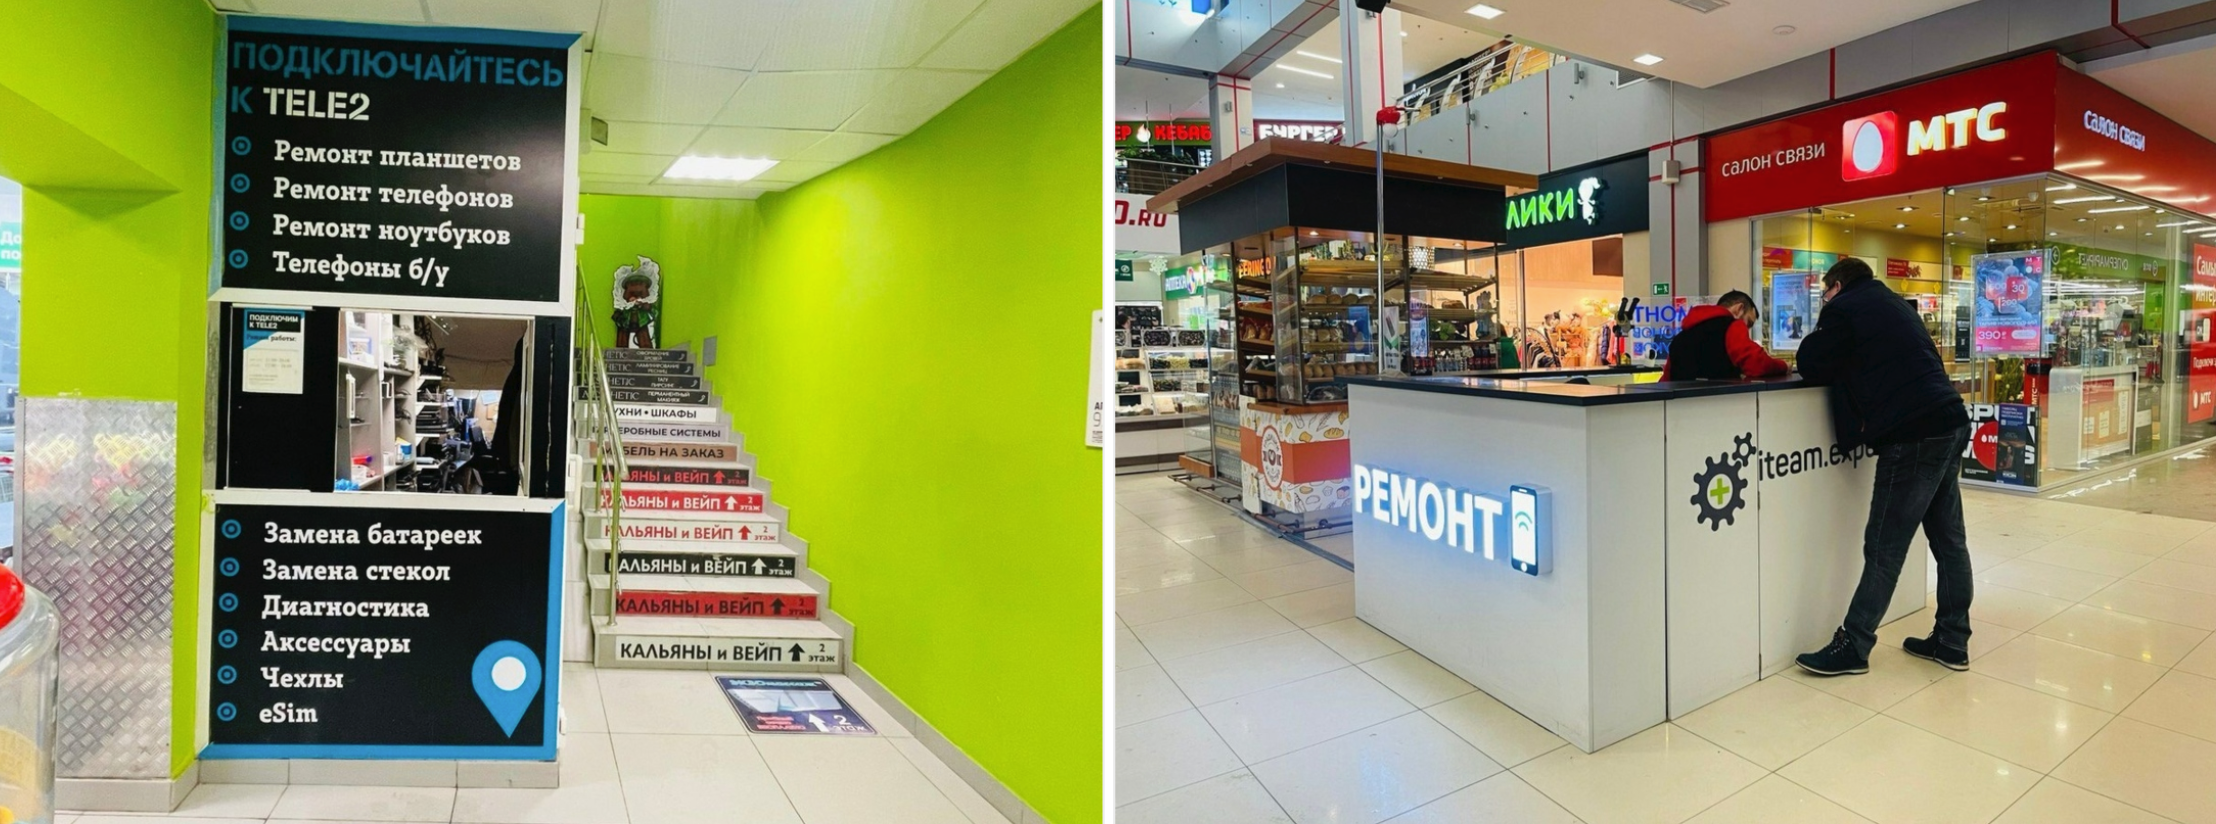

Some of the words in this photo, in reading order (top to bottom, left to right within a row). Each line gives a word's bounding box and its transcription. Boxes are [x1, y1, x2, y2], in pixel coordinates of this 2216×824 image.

[232, 42, 564, 87] ПОДКЛЮЧАЙТЕСЬ
[231, 86, 253, 113] К
[263, 87, 370, 121] TELE2
[1154, 124, 1212, 141] КЕБАБ
[1259, 124, 1338, 142] БУРГЕР
[1906, 101, 2007, 157] МТС
[2084, 110, 2118, 140] салон
[274, 139, 372, 165] Ремонт
[379, 148, 521, 171] планшетов
[1722, 154, 1771, 177] салон
[1776, 142, 1825, 166] связи
[273, 176, 371, 203] Ремонт
[379, 184, 514, 211] телефонов
[272, 214, 370, 240] Ремонт
[378, 222, 511, 249] ноутбуков
[272, 251, 401, 281] Телефоны
[408, 257, 449, 287] б/у
[249, 314, 299, 322] ПОДКЛЮЧИМ
[651, 408, 697, 419] ШКАФЫ
[670, 428, 721, 438] СИСТЕМЫ
[602, 446, 656, 456] МБЕЛЬ
[660, 447, 678, 457] НА
[682, 447, 724, 459] ЗАКАЗ
[663, 474, 671, 482] и
[674, 469, 709, 484] ВЕЙП
[735, 470, 741, 478] 2
[671, 500, 680, 509] и
[683, 492, 720, 510] ВЕЙП
[747, 496, 753, 504] 2
[1354, 464, 1503, 560] РЕМОНТ
[264, 522, 360, 544] Замена
[367, 523, 482, 550] батареек
[681, 529, 689, 539] и
[694, 524, 733, 540] ВЕЙП
[763, 525, 768, 533] 2
[262, 559, 358, 581] Замена
[366, 566, 451, 581] стекол
[691, 563, 700, 573] и
[704, 556, 747, 575] ВЕЙП
[769, 568, 793, 576] этаж
[778, 559, 784, 568] 2
[261, 595, 430, 620] Диагностика
[616, 598, 699, 615] КАЛЬЯНЫ
[704, 604, 713, 615] и
[719, 596, 764, 616] ВЕЙП
[799, 598, 805, 607] 2
[788, 608, 814, 616] этаж
[260, 631, 411, 659] Аксессуары
[621, 643, 711, 660] КАЛЬЯНЫ
[717, 650, 727, 660] и
[733, 642, 782, 662] ВЕЙП
[819, 643, 826, 653] 2
[808, 654, 836, 663] этаж
[260, 667, 343, 688] Чехлы
[259, 703, 318, 723] eSim
[833, 714, 851, 726] 2
